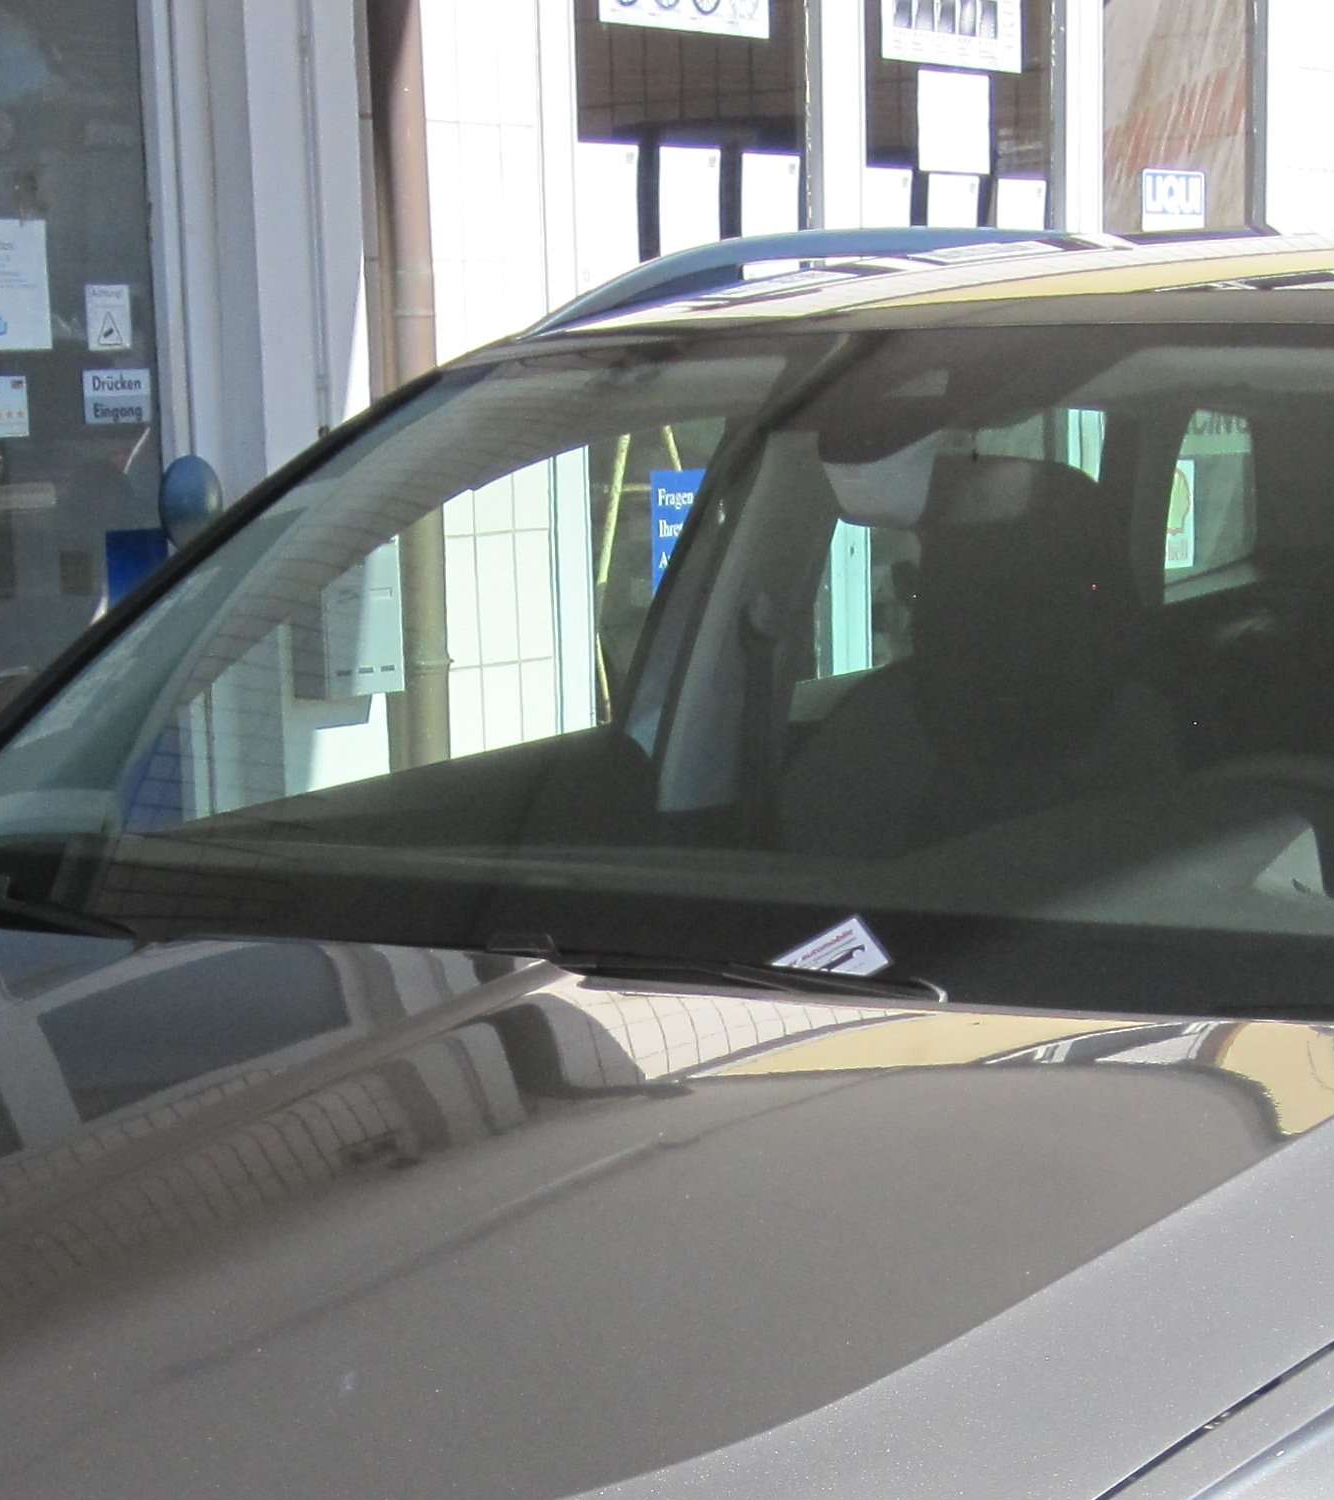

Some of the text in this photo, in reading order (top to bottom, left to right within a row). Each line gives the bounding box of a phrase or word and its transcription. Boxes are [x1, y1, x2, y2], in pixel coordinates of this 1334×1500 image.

[1145, 174, 1202, 214] LIQUI
[92, 374, 142, 392] Drücken
[93, 402, 143, 422] Eingang
[658, 487, 694, 510] Fragen
